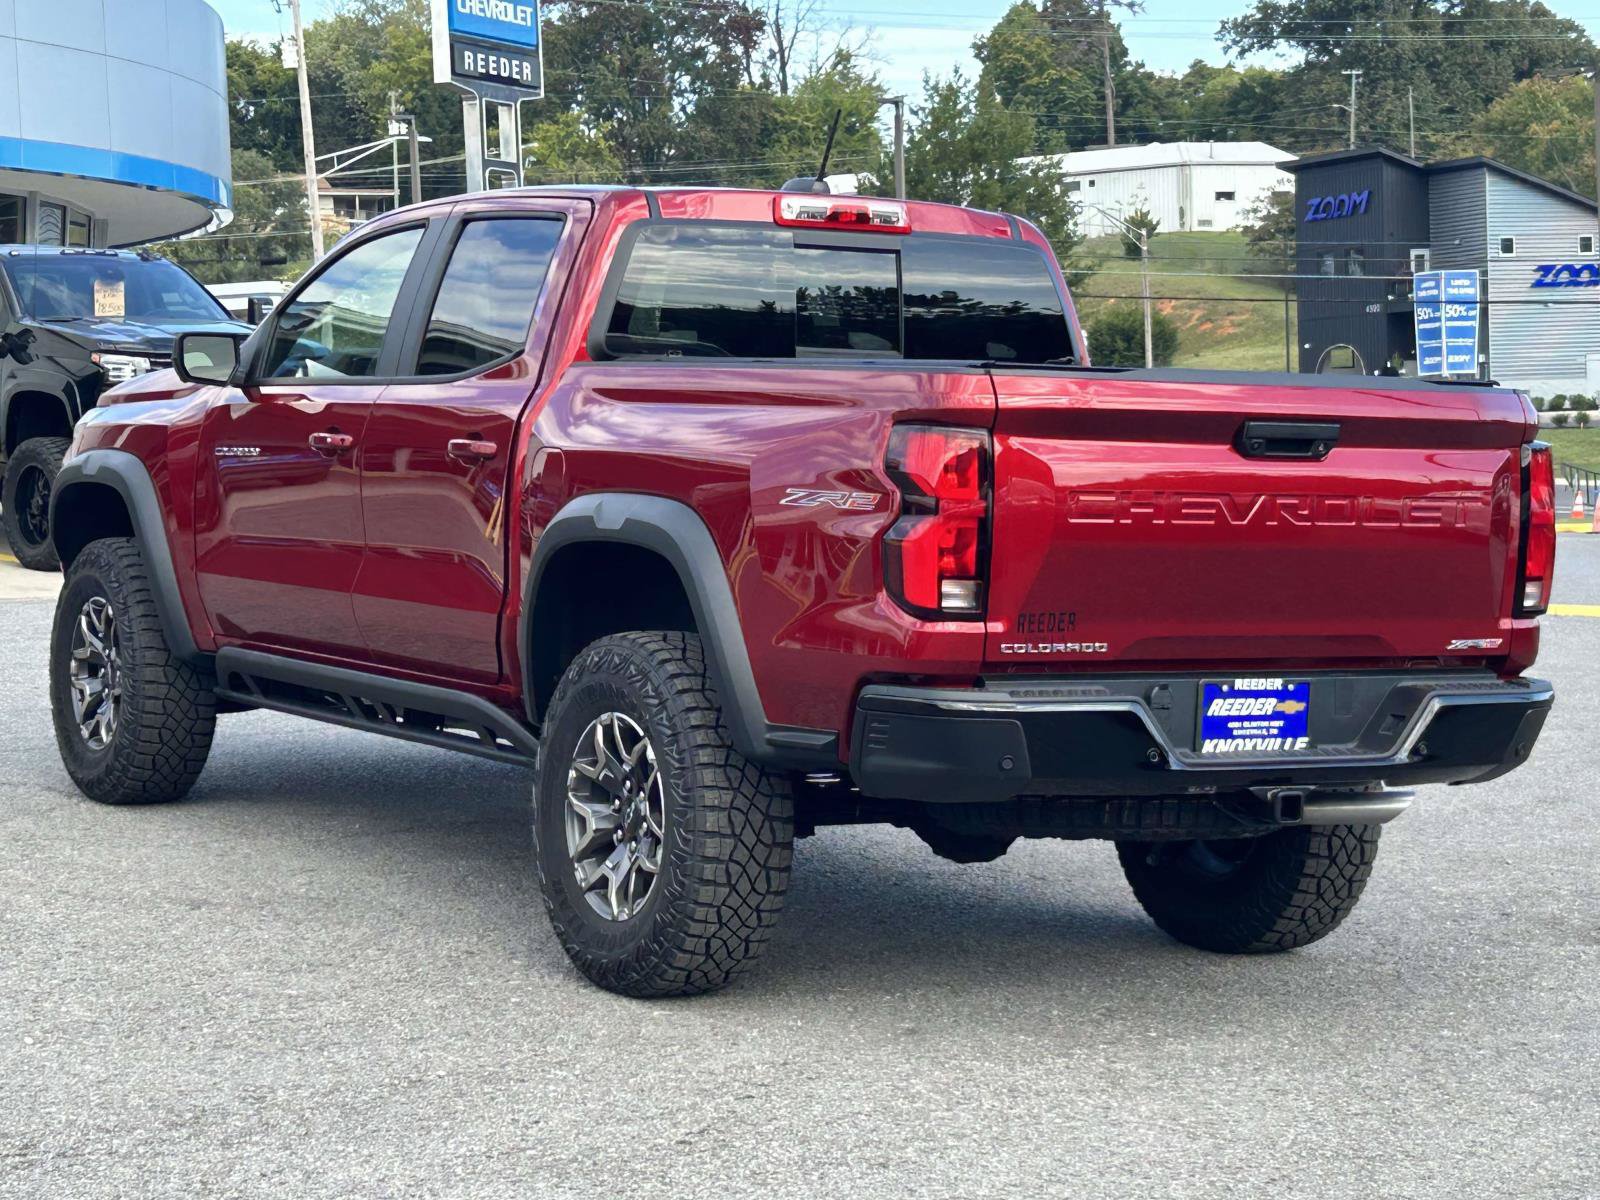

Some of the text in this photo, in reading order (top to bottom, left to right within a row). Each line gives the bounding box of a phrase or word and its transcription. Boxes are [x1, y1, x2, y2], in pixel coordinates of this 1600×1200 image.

[457, 0, 533, 27] CHEVROLET
[463, 50, 532, 81] REEDER
[1303, 190, 1369, 222] ZOOM
[1530, 264, 1600, 288] ZOO
[1445, 303, 1467, 318] 50%
[779, 488, 882, 511] ZR2
[1068, 489, 1483, 528] CHEVROLET
[1017, 611, 1077, 634] REEDER
[1000, 642, 1108, 653] COLORADO
[1234, 678, 1283, 690] REEDER
[1207, 697, 1278, 716] REEDER
[1201, 737, 1310, 754] KNOXVILLE
